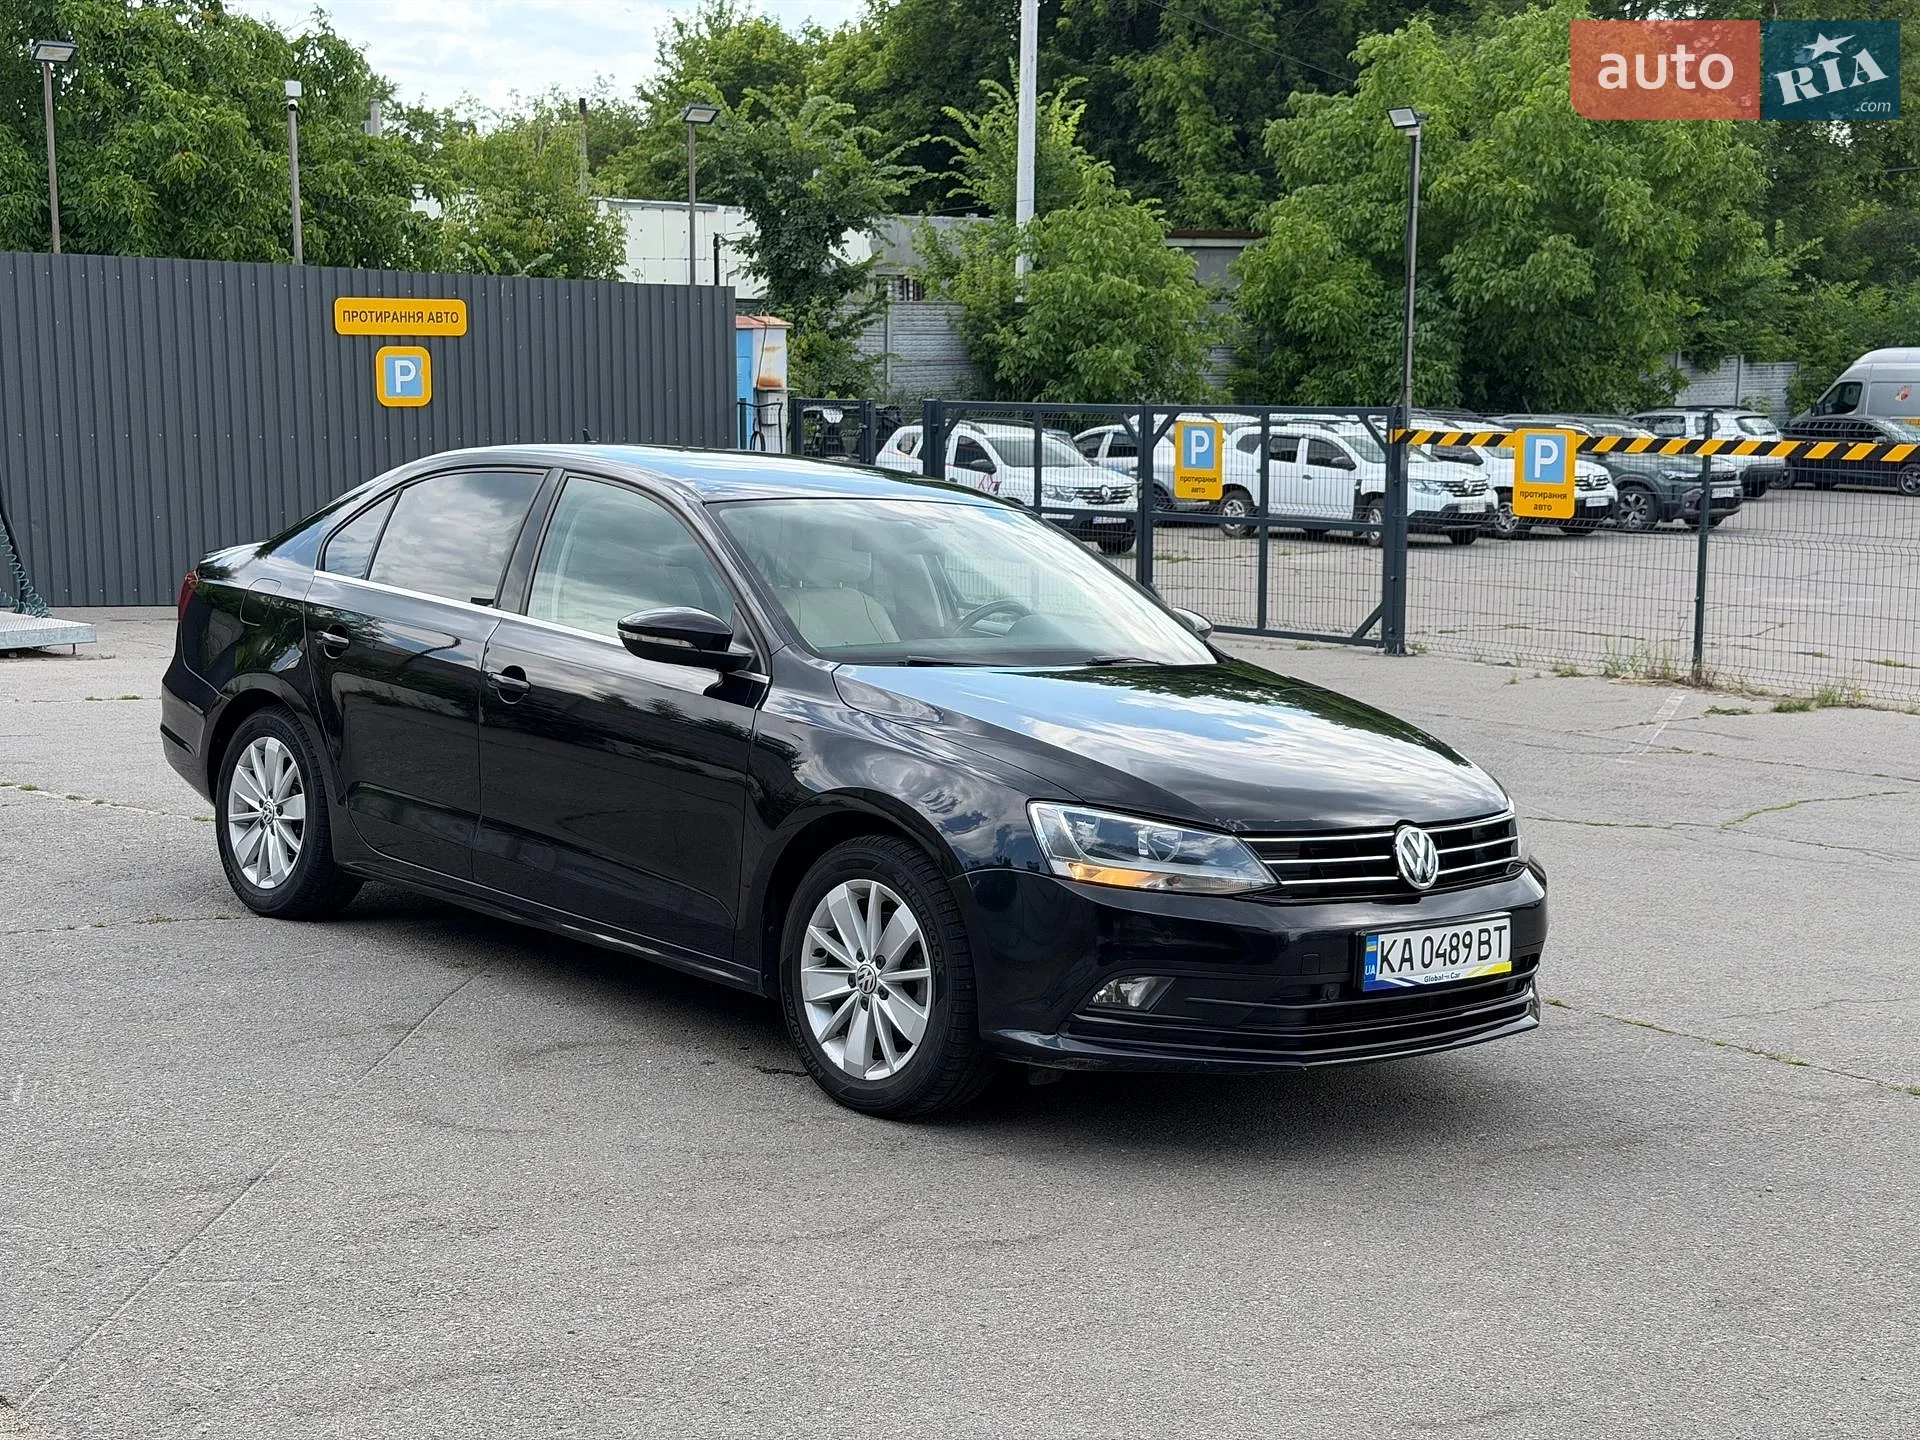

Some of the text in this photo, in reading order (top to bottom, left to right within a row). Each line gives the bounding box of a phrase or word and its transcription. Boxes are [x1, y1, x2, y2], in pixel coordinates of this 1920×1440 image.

[342, 310, 459, 324] ПРОТИРАННЯ АВТО
[394, 360, 417, 393] P
[1190, 430, 1210, 465] P
[1534, 438, 1559, 478] P
[1519, 490, 1567, 500] протирання
[1533, 503, 1552, 511] авто
[1379, 925, 1508, 975] KA 0489 BT
[1364, 964, 1376, 976] UA
[1423, 974, 1444, 983] Global
